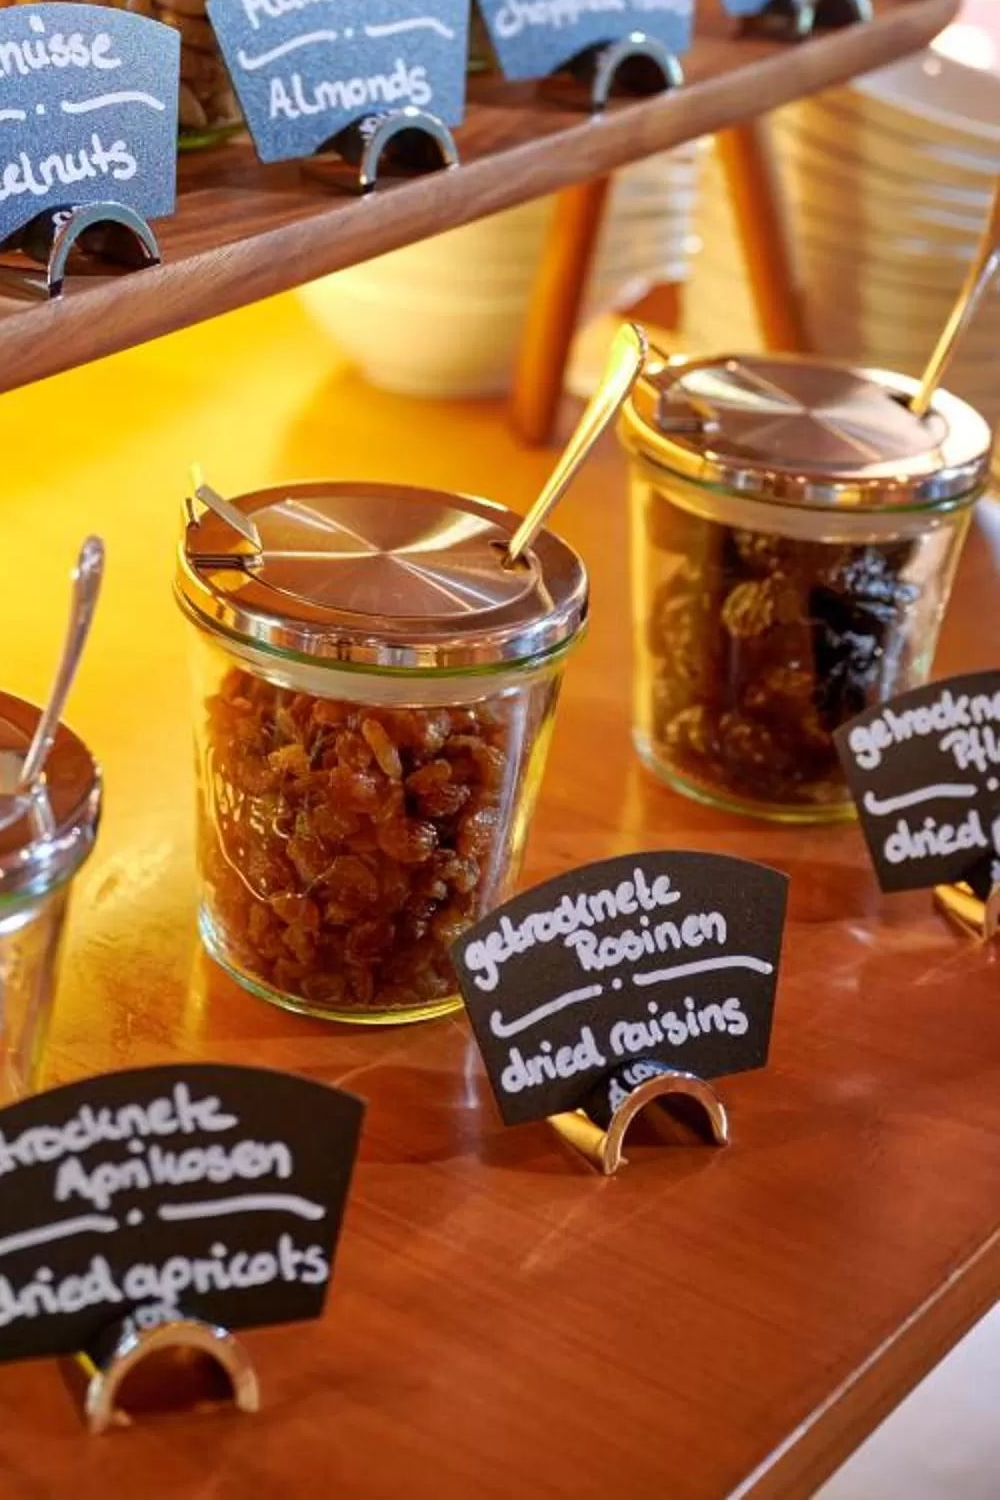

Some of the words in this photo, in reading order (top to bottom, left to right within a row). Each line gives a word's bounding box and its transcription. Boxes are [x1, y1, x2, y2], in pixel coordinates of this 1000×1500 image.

[268, 57, 432, 119] Almonds
[884, 809, 989, 864] dried
[464, 867, 682, 992] getrocknete
[563, 911, 727, 970] Rosinen
[500, 1025, 607, 1093] dried
[609, 997, 749, 1055] raisins
[54, 1139, 293, 1209] Aprikosen
[122, 1231, 330, 1306] apricots
